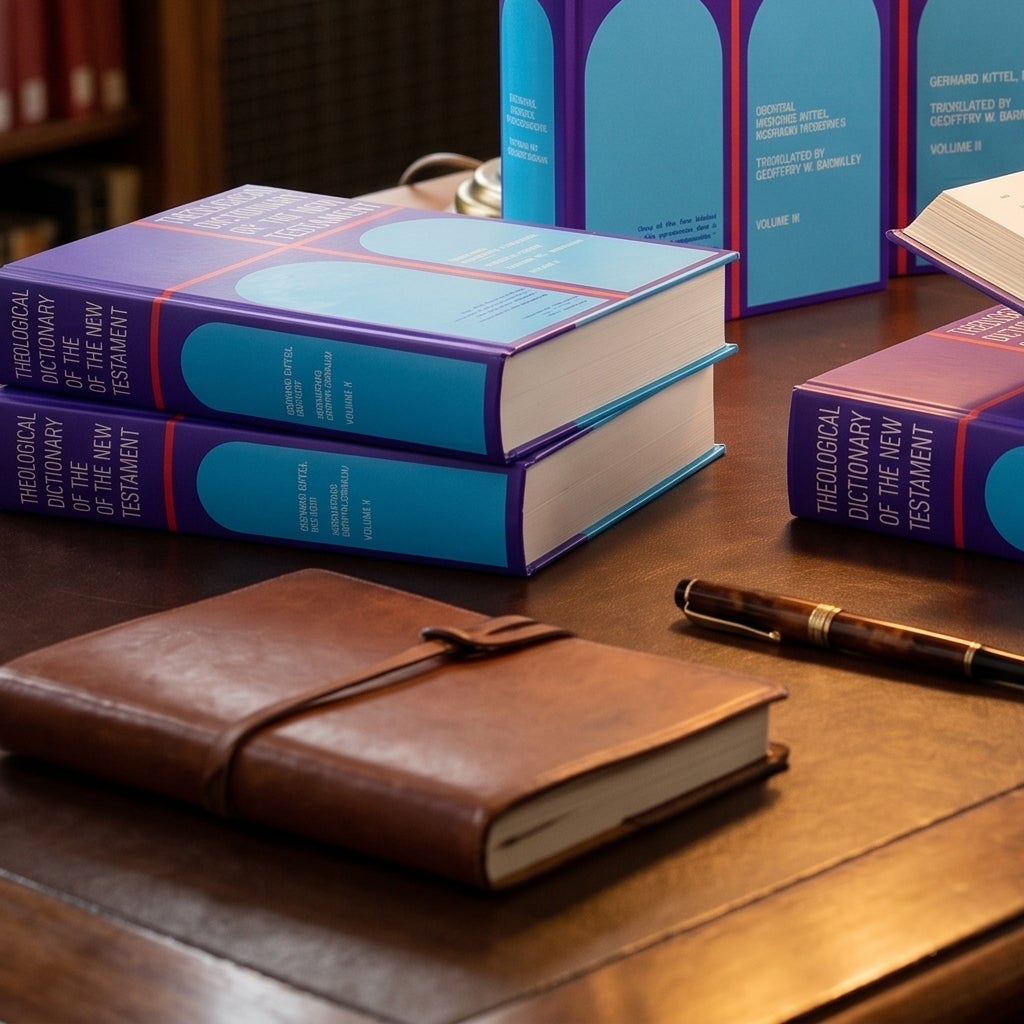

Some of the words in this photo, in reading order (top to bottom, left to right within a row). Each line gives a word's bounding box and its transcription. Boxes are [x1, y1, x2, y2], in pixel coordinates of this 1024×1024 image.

[930, 140, 972, 155] VOLUME
[12, 289, 33, 380] THEOLOGICAL
[85, 301, 104, 338] NEW
[38, 293, 59, 384] DICTIONARY
[62, 335, 81, 364] THE
[85, 340, 104, 370] THE
[110, 305, 131, 396] TESTAMENT
[64, 369, 83, 389] OF
[87, 375, 107, 394] OF
[93, 422, 113, 461] NEW
[878, 416, 903, 460] NEW
[16, 412, 39, 505] THEOLOGICAL
[44, 416, 66, 509] DICTIONARY
[70, 460, 89, 489] THE
[119, 426, 141, 518] TESTAMENT
[815, 405, 841, 513] THEOLOGICAL
[847, 409, 872, 521] DICTIONARY
[908, 423, 934, 531] TESTAMENT
[93, 464, 113, 492] THE
[878, 464, 900, 496] THE
[72, 493, 91, 512] OF
[95, 497, 115, 516] OF
[879, 502, 900, 527] OF
